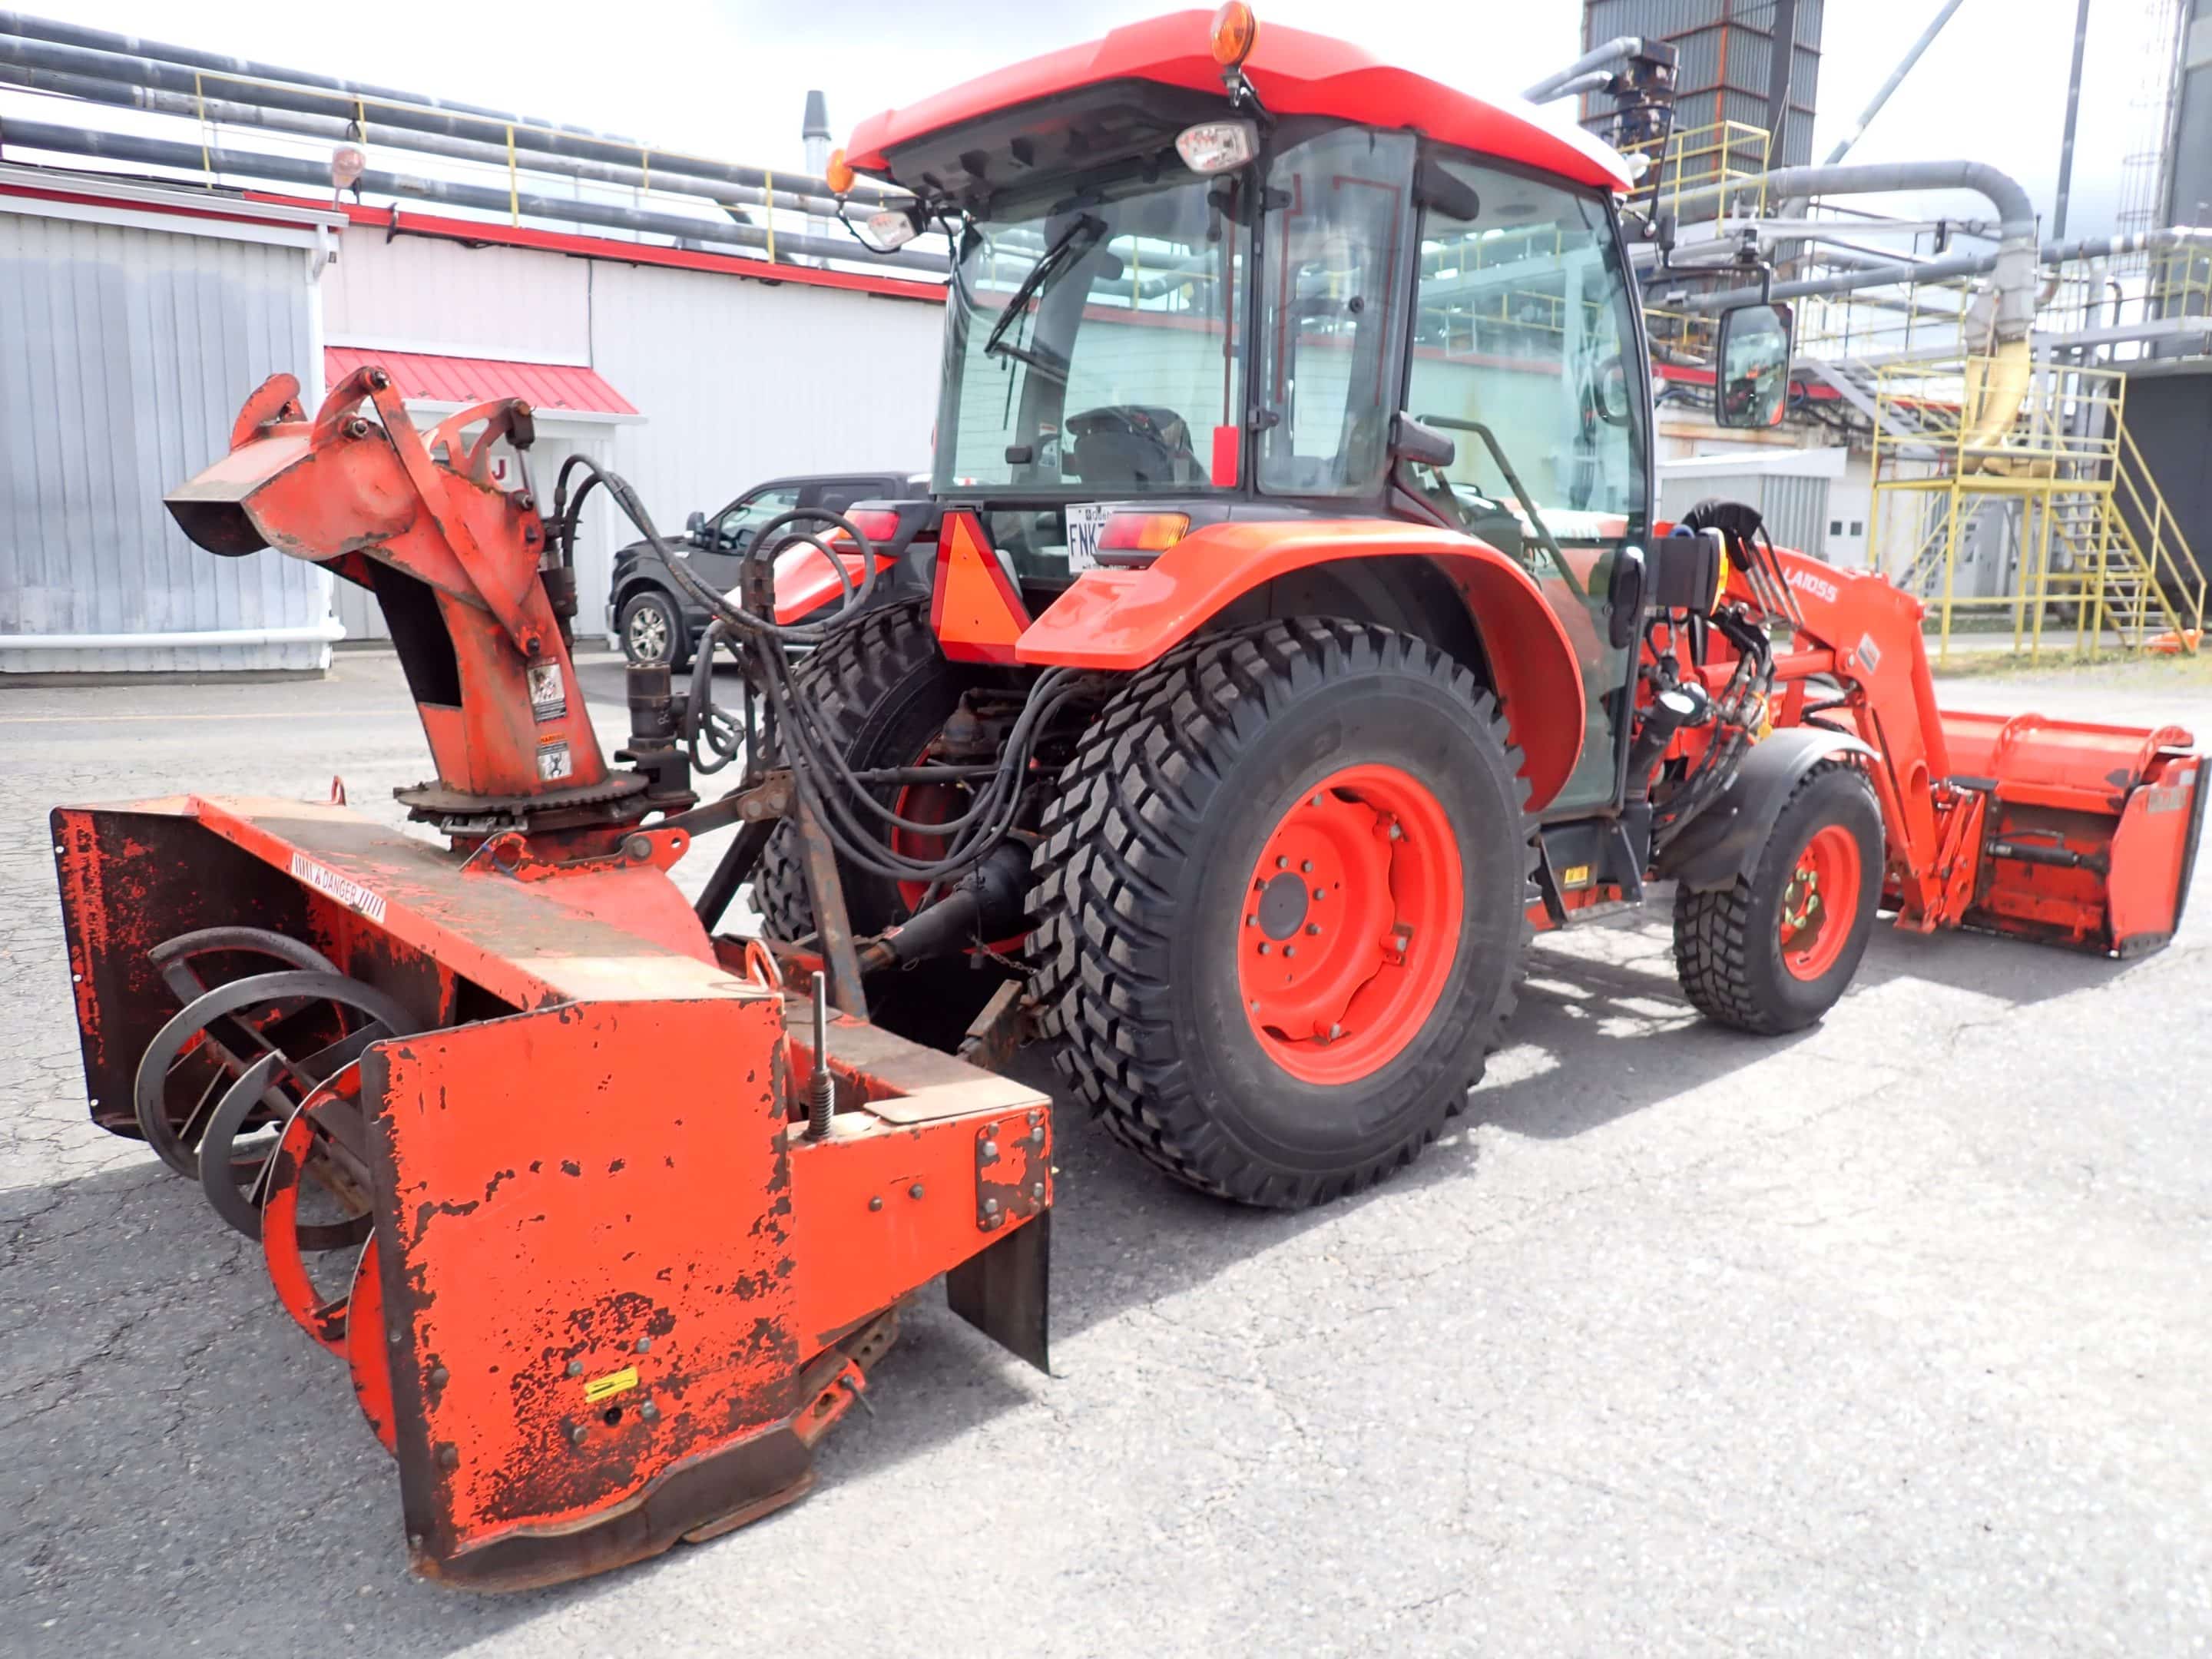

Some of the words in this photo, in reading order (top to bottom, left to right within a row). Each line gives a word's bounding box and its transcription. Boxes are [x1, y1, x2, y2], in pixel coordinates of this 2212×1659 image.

[1069, 523, 1105, 556] FNK
[1783, 567, 1838, 603] LA1055
[323, 872, 357, 904] DANGER
